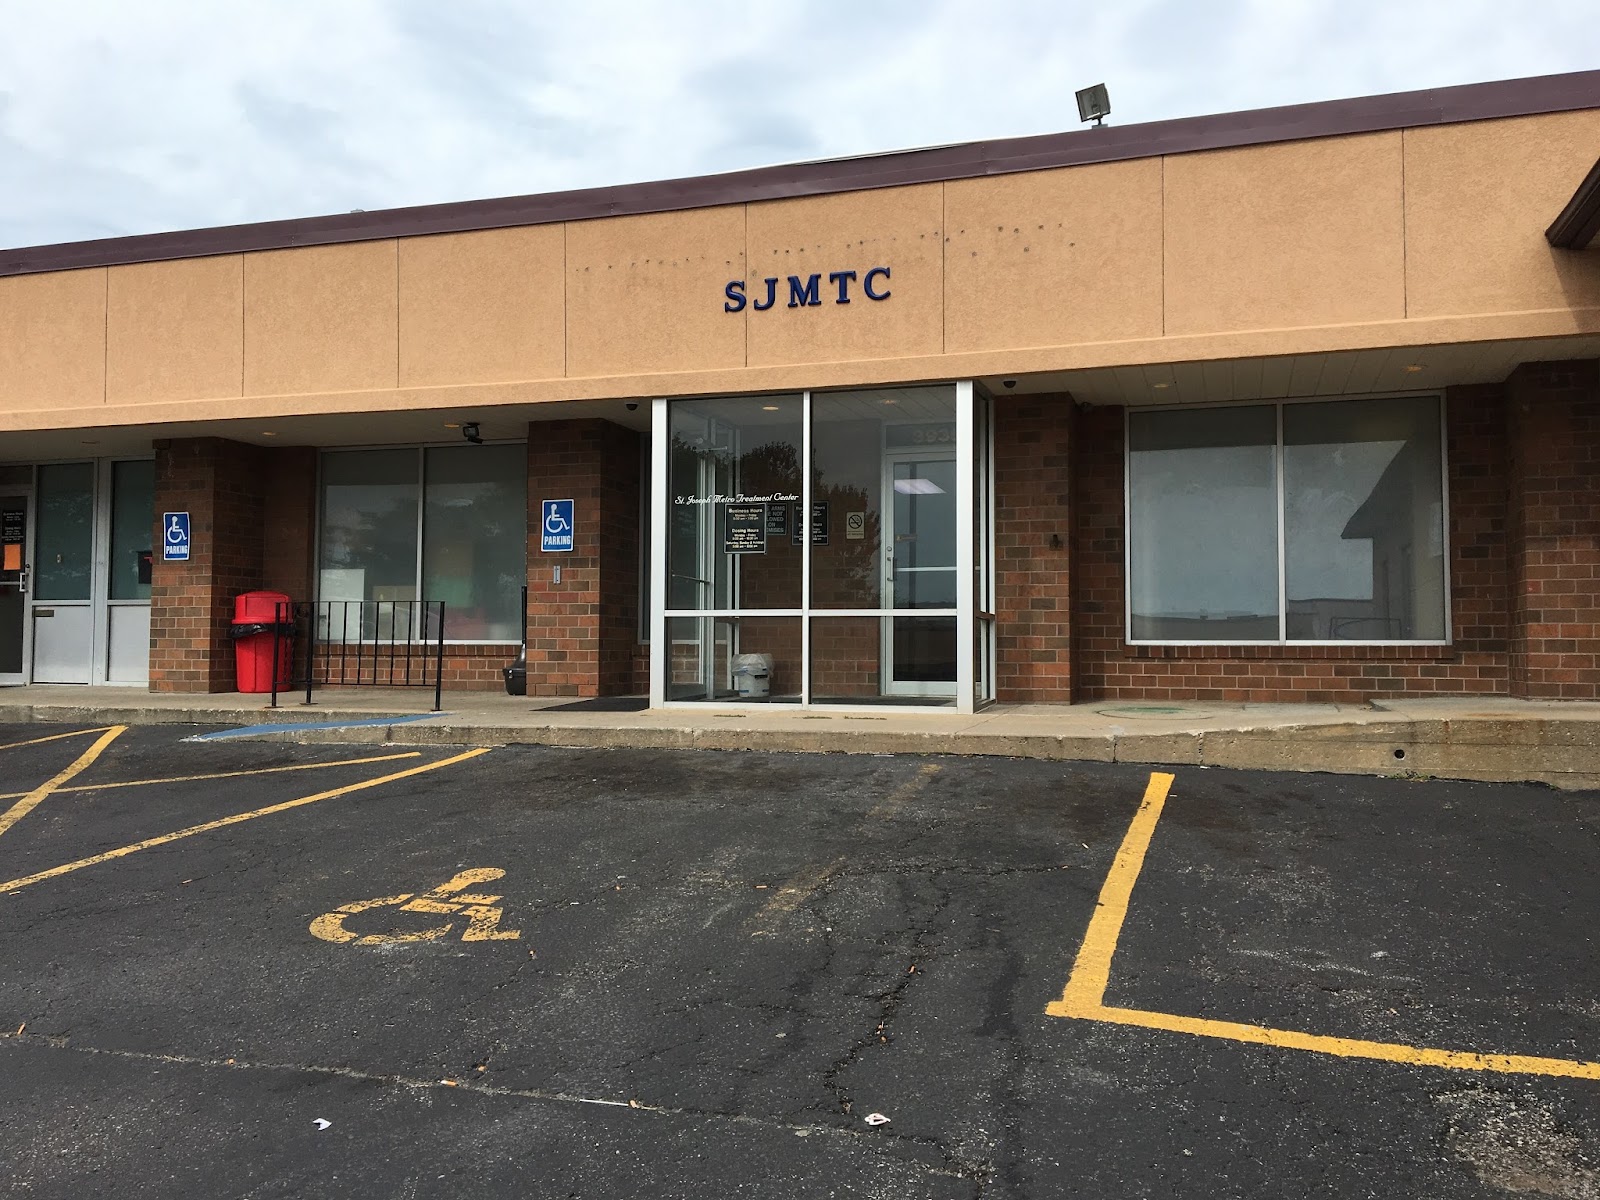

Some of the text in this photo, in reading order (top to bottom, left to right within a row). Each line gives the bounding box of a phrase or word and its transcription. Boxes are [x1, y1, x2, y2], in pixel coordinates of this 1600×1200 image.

[724, 267, 891, 313] SJMTC
[674, 492, 799, 506] St. Joseph Metro Treatment Center
[544, 535, 571, 545] PARKING
[166, 545, 188, 555] PARKING
